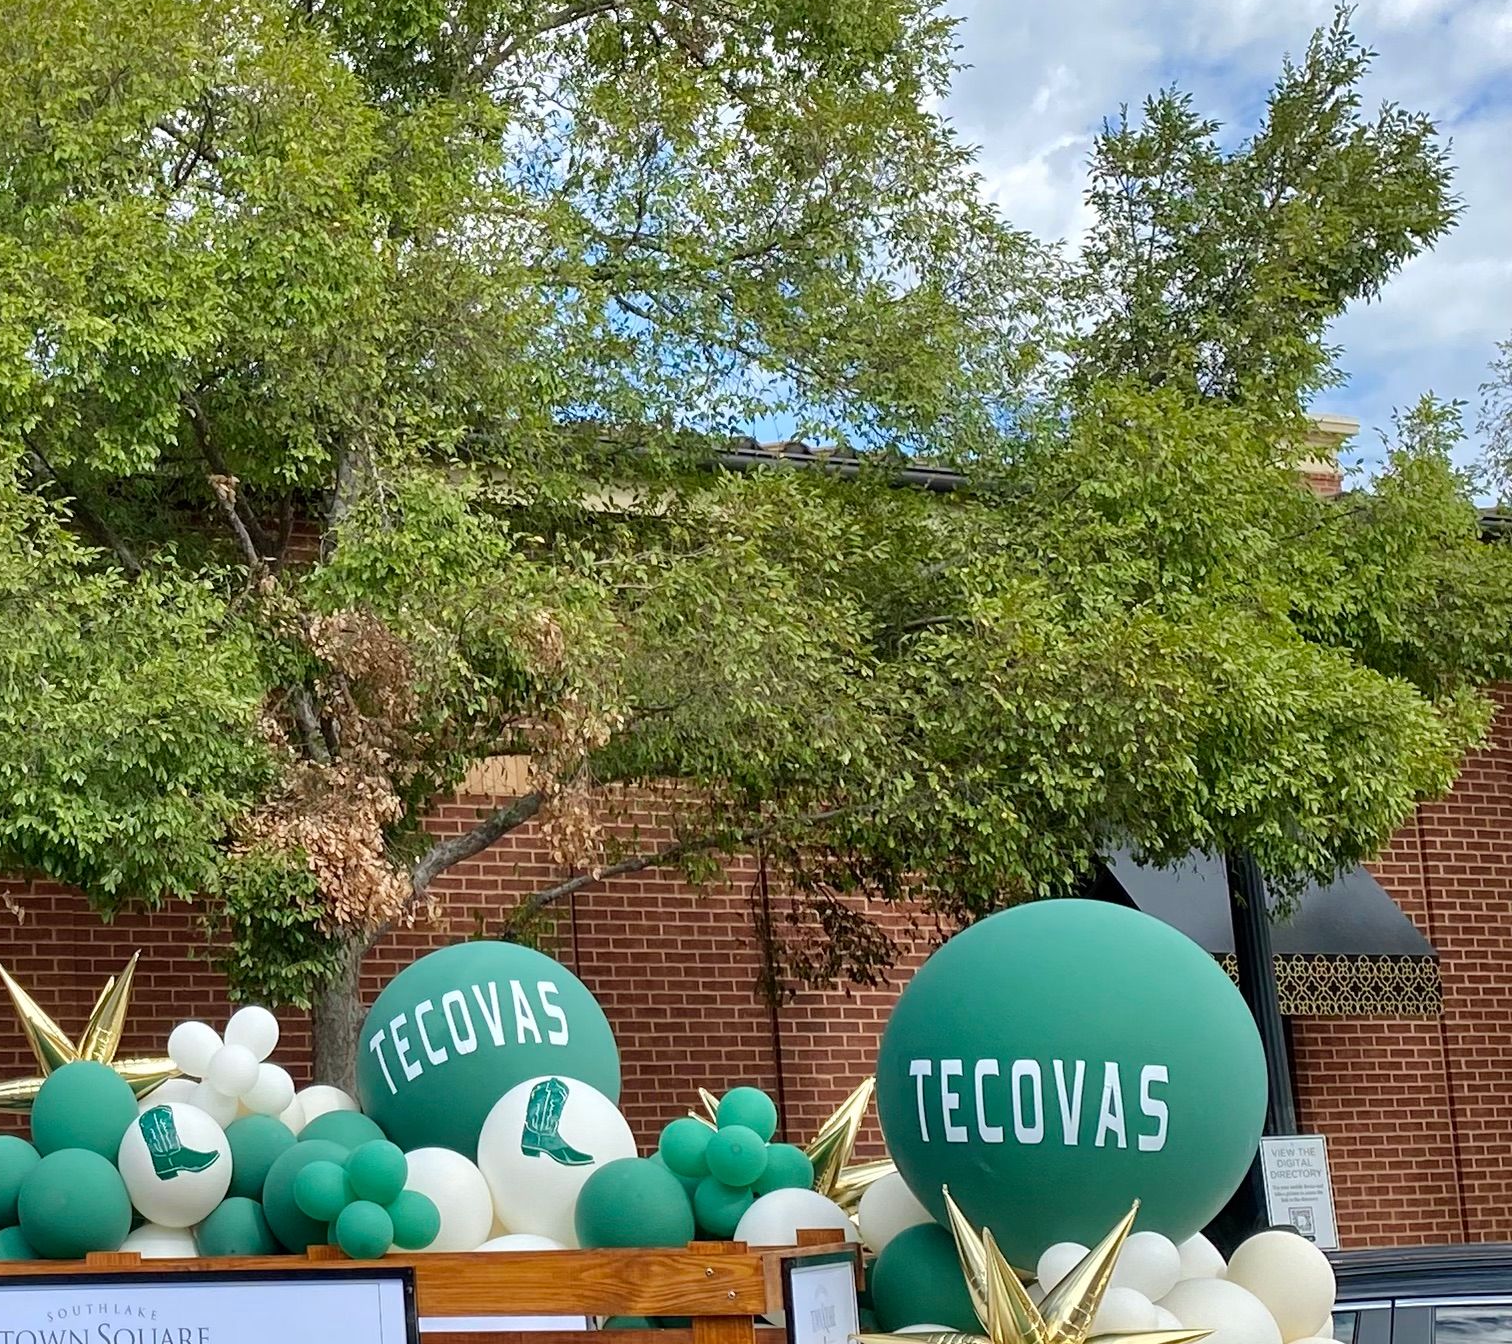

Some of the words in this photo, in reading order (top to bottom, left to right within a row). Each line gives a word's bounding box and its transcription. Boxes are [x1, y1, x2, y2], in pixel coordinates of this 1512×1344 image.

[369, 980, 569, 1094] TECOVAS
[909, 1059, 1170, 1152] TECOVAS
[1271, 1148, 1295, 1157] VIEW
[1298, 1147, 1316, 1156] THE
[1277, 1159, 1313, 1168] DIGITAL
[1270, 1169, 1322, 1179] DIRECTORY
[47, 1303, 158, 1323] SOUTHLAKE
